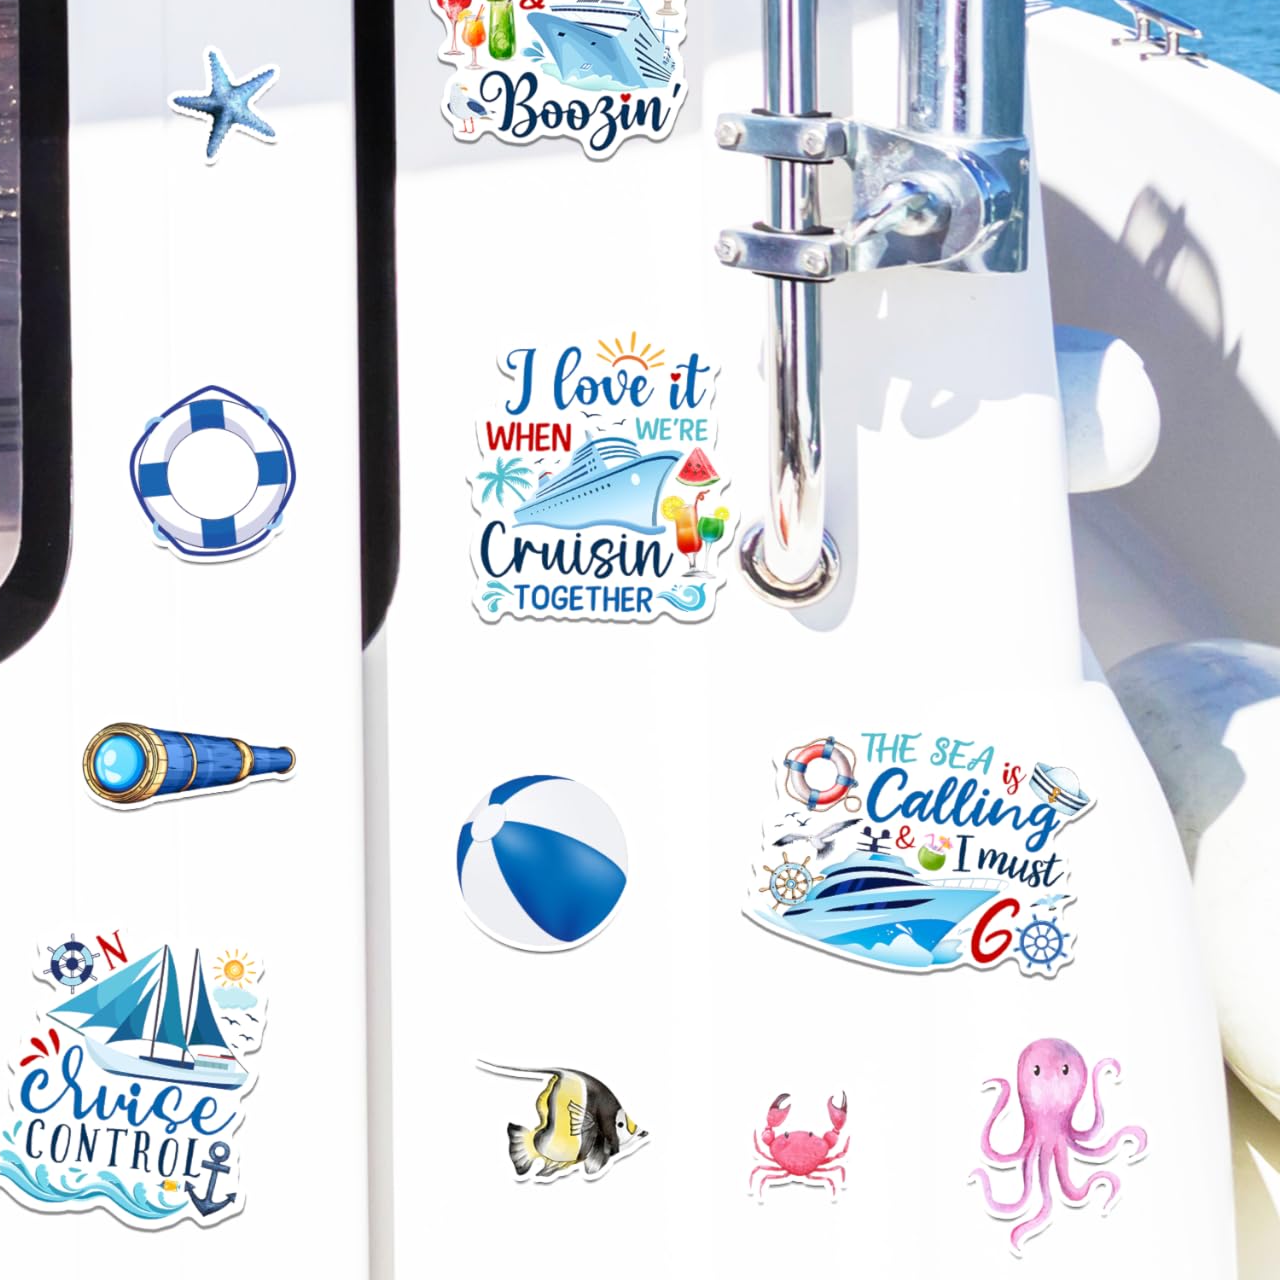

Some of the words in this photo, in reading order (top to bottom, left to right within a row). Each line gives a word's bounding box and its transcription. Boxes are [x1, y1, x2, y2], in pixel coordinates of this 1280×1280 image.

[479, 70, 681, 151] Boozin'
[505, 348, 536, 415] I
[553, 346, 655, 410] love
[669, 353, 710, 410] it
[486, 421, 571, 452] WHEN
[635, 417, 708, 441] WE'RE
[480, 520, 674, 579] Cruisin
[514, 584, 653, 612] TOGETHER
[861, 732, 922, 763] THE
[930, 736, 995, 775] SEA
[1002, 762, 1027, 795] is
[866, 767, 1061, 852] Calling
[895, 825, 915, 849] &
[952, 835, 975, 872] I
[977, 847, 1065, 888] must
[25, 1118, 201, 1178] CONTROL
